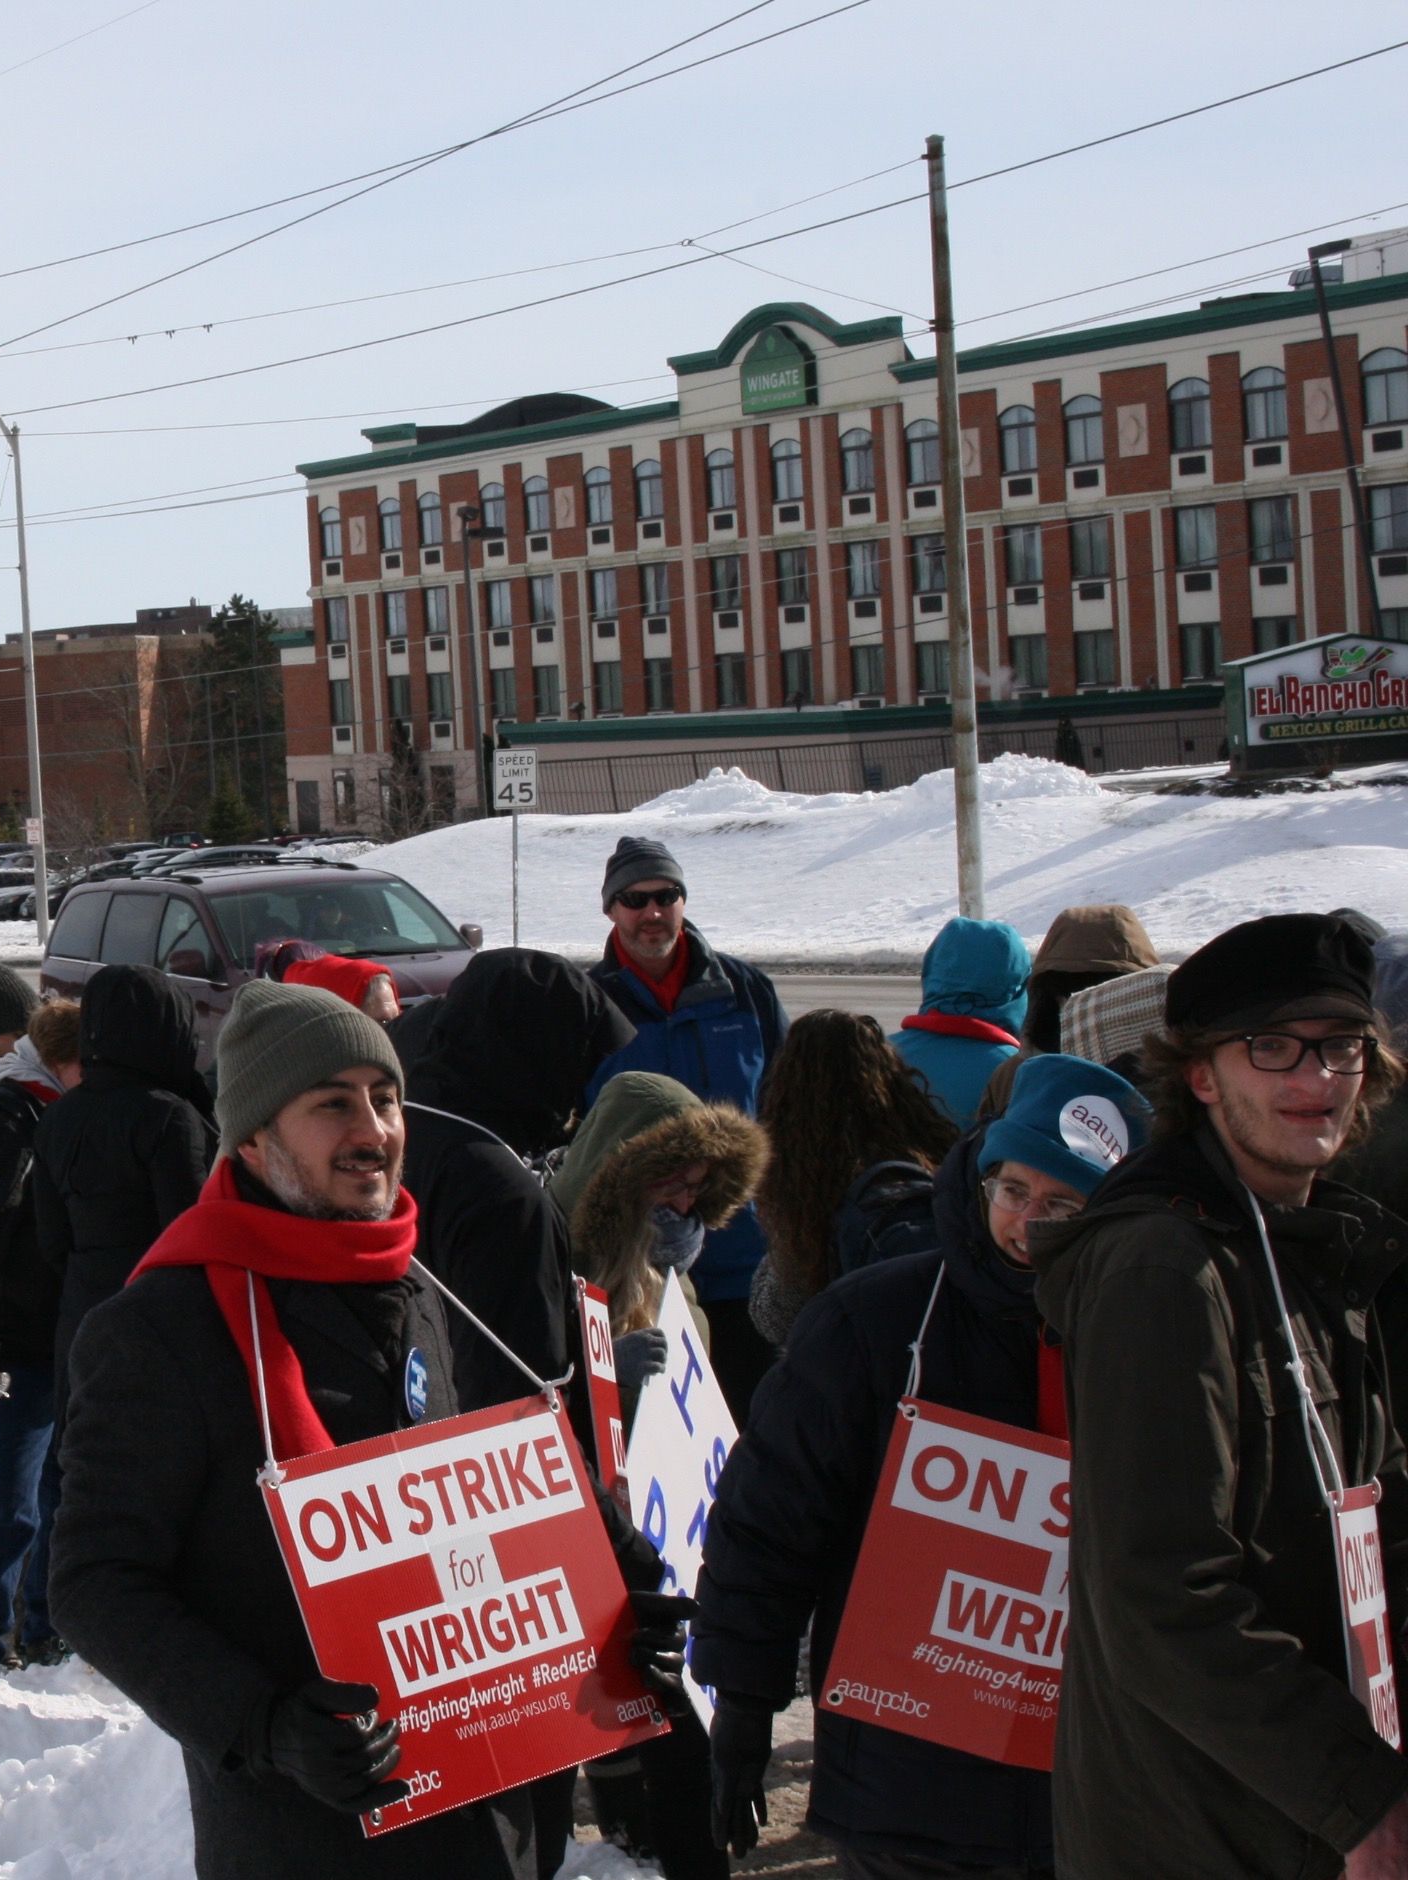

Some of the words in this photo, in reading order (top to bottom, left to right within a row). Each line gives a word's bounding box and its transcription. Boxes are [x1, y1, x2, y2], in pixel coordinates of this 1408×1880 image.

[746, 368, 800, 392] WINGATE
[1255, 686, 1283, 717] EL
[1284, 675, 1373, 718] RANCHO
[1269, 721, 1333, 738] MEXICAN
[1335, 718, 1378, 733] GRILL
[498, 756, 534, 766] SPEED
[502, 768, 529, 778] LIMIT
[497, 782, 533, 803] 45
[1071, 1105, 1122, 1160] aaup
[589, 1315, 612, 1367] ON
[299, 1484, 393, 1562] ON
[397, 1434, 574, 1535] STRIKE
[911, 1445, 1028, 1523] ON
[448, 1549, 486, 1591] for
[1345, 1535, 1368, 1606] ON
[386, 1578, 569, 1683] WRIGHT
[946, 1581, 1068, 1657] WRI
[399, 1673, 527, 1733] #fighting4wright
[531, 1646, 597, 1688] #Red4Ed
[912, 1642, 1059, 1702] #fighting4wrig
[455, 1691, 571, 1741] www.aaup-wsu.org
[616, 1695, 656, 1725] aaup
